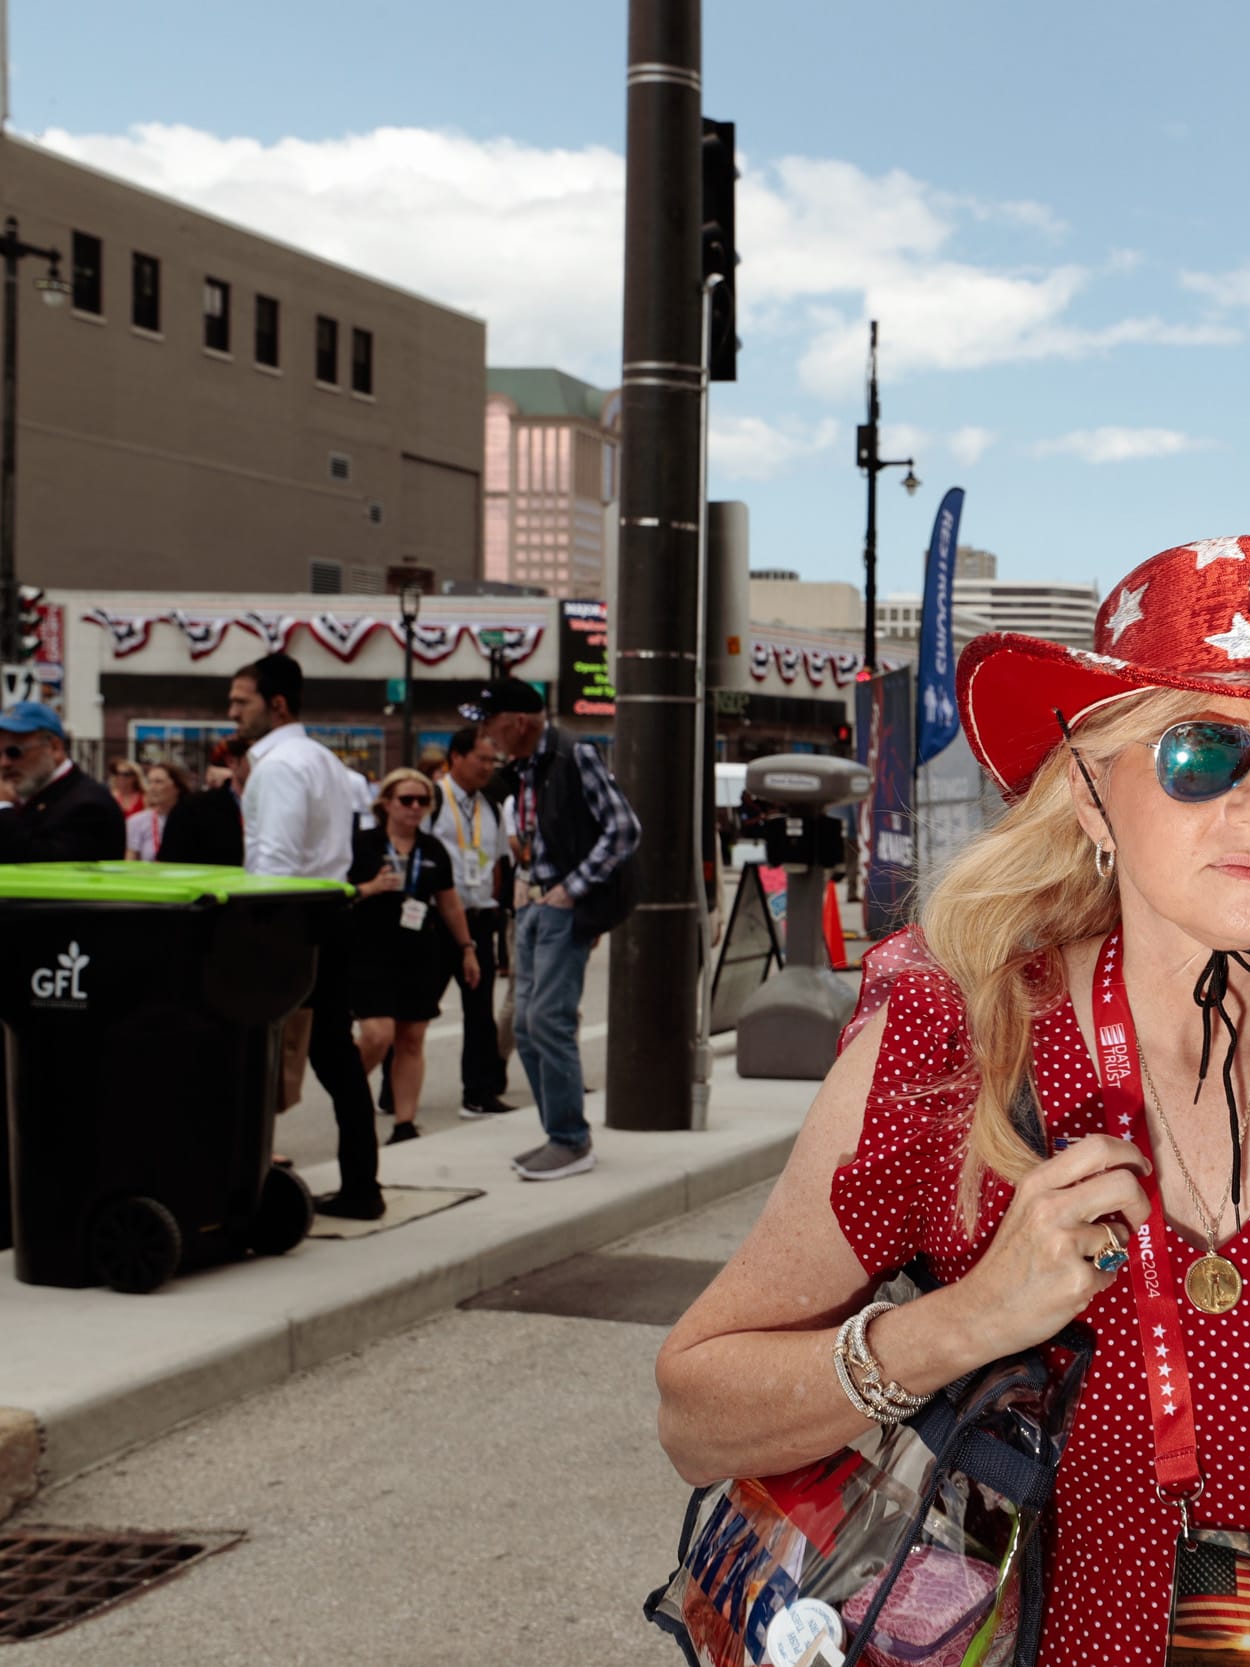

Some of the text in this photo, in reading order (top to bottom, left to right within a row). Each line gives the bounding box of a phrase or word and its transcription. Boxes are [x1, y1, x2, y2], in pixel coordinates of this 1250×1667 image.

[31, 958, 89, 999] GFL
[1103, 1046, 1121, 1088] TRUST
[1115, 1044, 1131, 1079] DATA
[1137, 1224, 1161, 1299] RNC2024
[786, 1631, 803, 1655] PUSH
